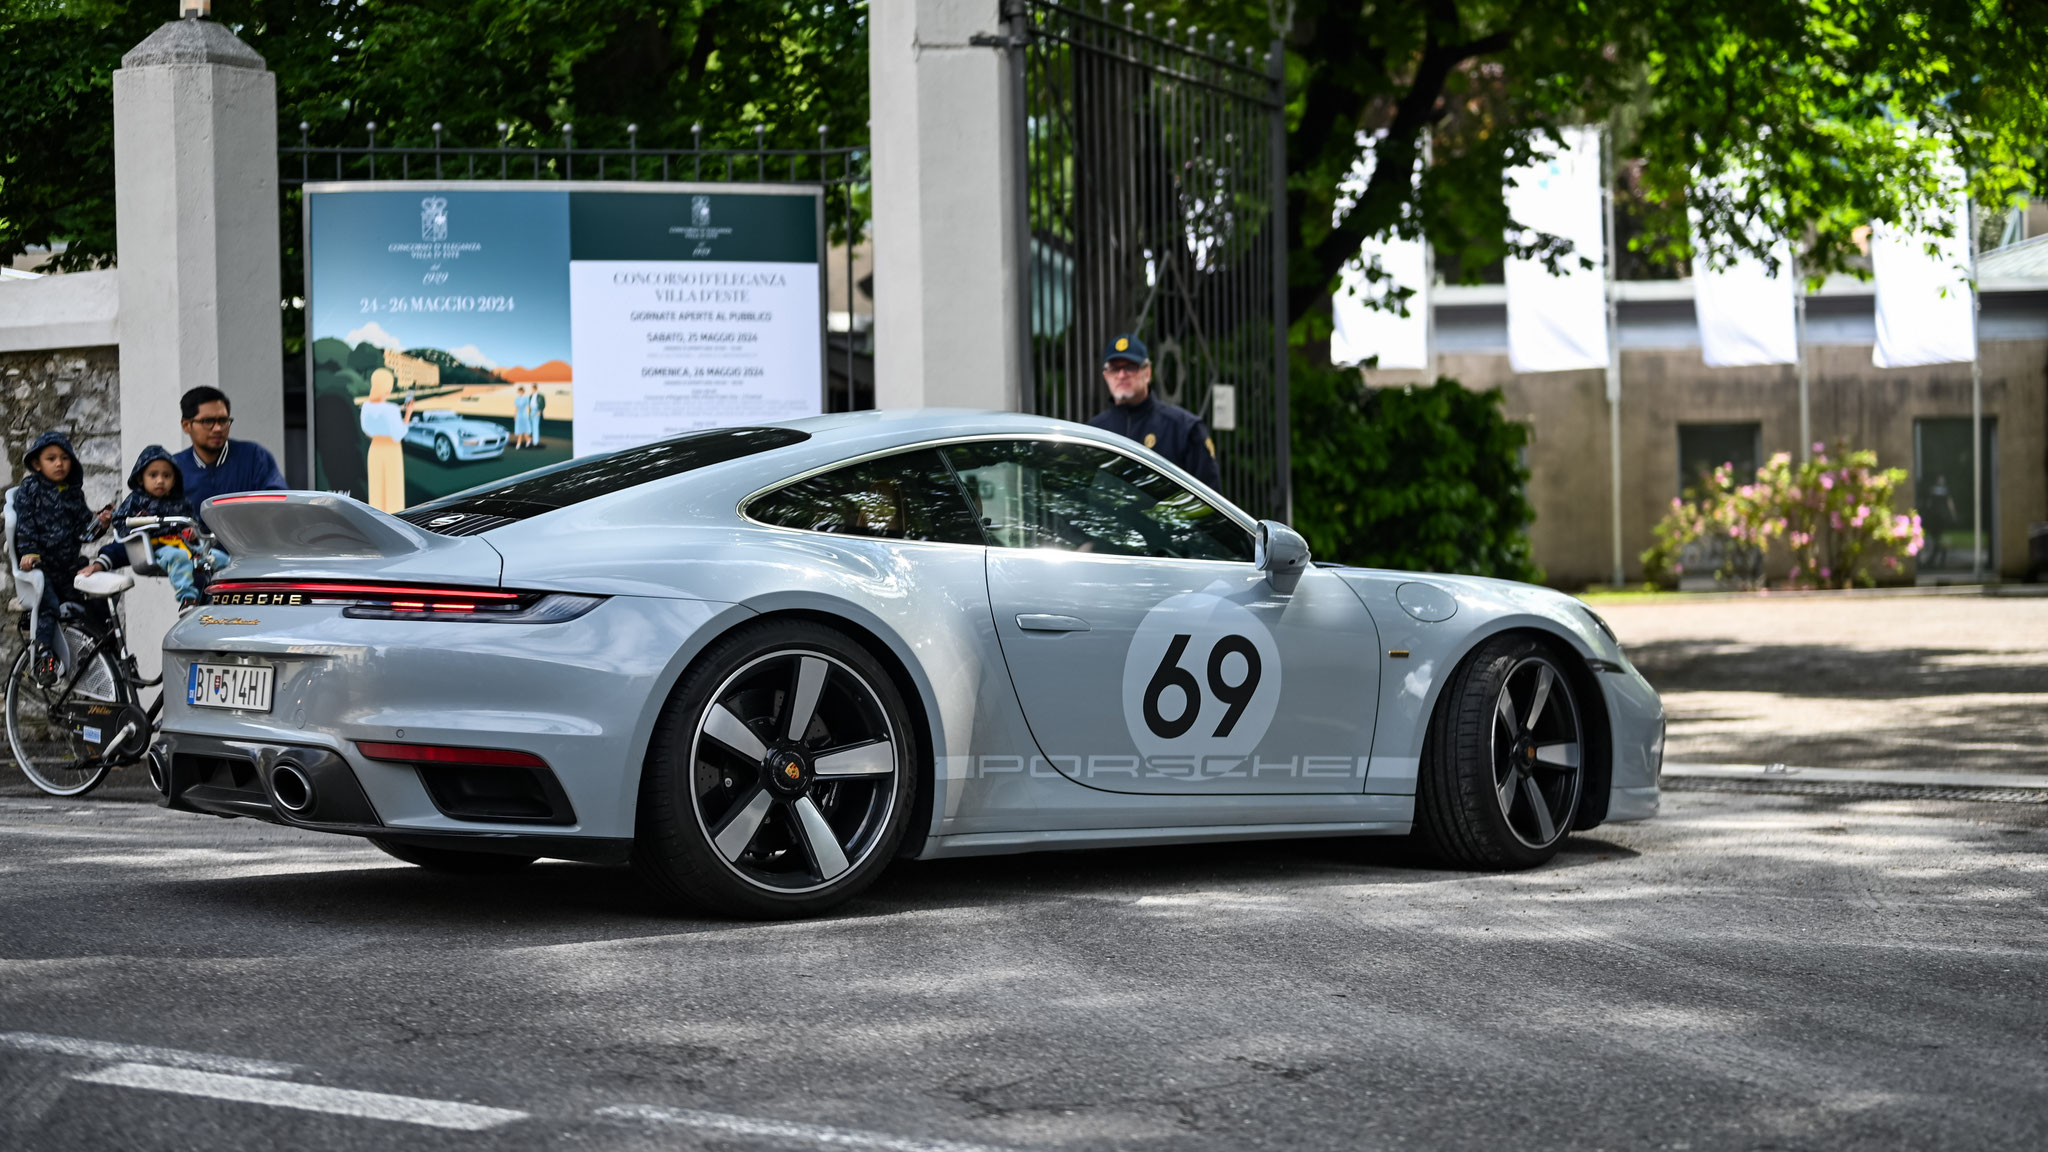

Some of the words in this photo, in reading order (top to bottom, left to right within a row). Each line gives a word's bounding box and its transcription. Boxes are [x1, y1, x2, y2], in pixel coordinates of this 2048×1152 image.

[613, 271, 696, 286] CONCORSO
[700, 271, 787, 287] D'ELEGANZA
[655, 289, 697, 302] VILLA
[700, 289, 750, 302] D'ESTE
[360, 297, 378, 313] 24
[389, 296, 408, 313] 26
[411, 295, 475, 312] MAGGIO
[477, 295, 515, 312] 2024
[630, 311, 676, 322] GIORNATE
[678, 311, 713, 322] APERTE
[715, 311, 726, 322] AL
[729, 311, 772, 322] PUBBLICO
[647, 332, 686, 344] SABATO,
[688, 332, 698, 343] 25
[700, 332, 734, 343] MAGGIO
[736, 332, 758, 343] 2024
[641, 367, 692, 378] DOMENICA,
[694, 367, 704, 377] 26
[706, 367, 741, 377] MAGGIO
[743, 367, 764, 377] 2024
[212, 593, 302, 605] PORSCHE
[195, 667, 214, 703] BT
[219, 669, 267, 707] 514HI
[1142, 633, 1262, 740] 69
[979, 754, 1352, 779] PORSCHE
